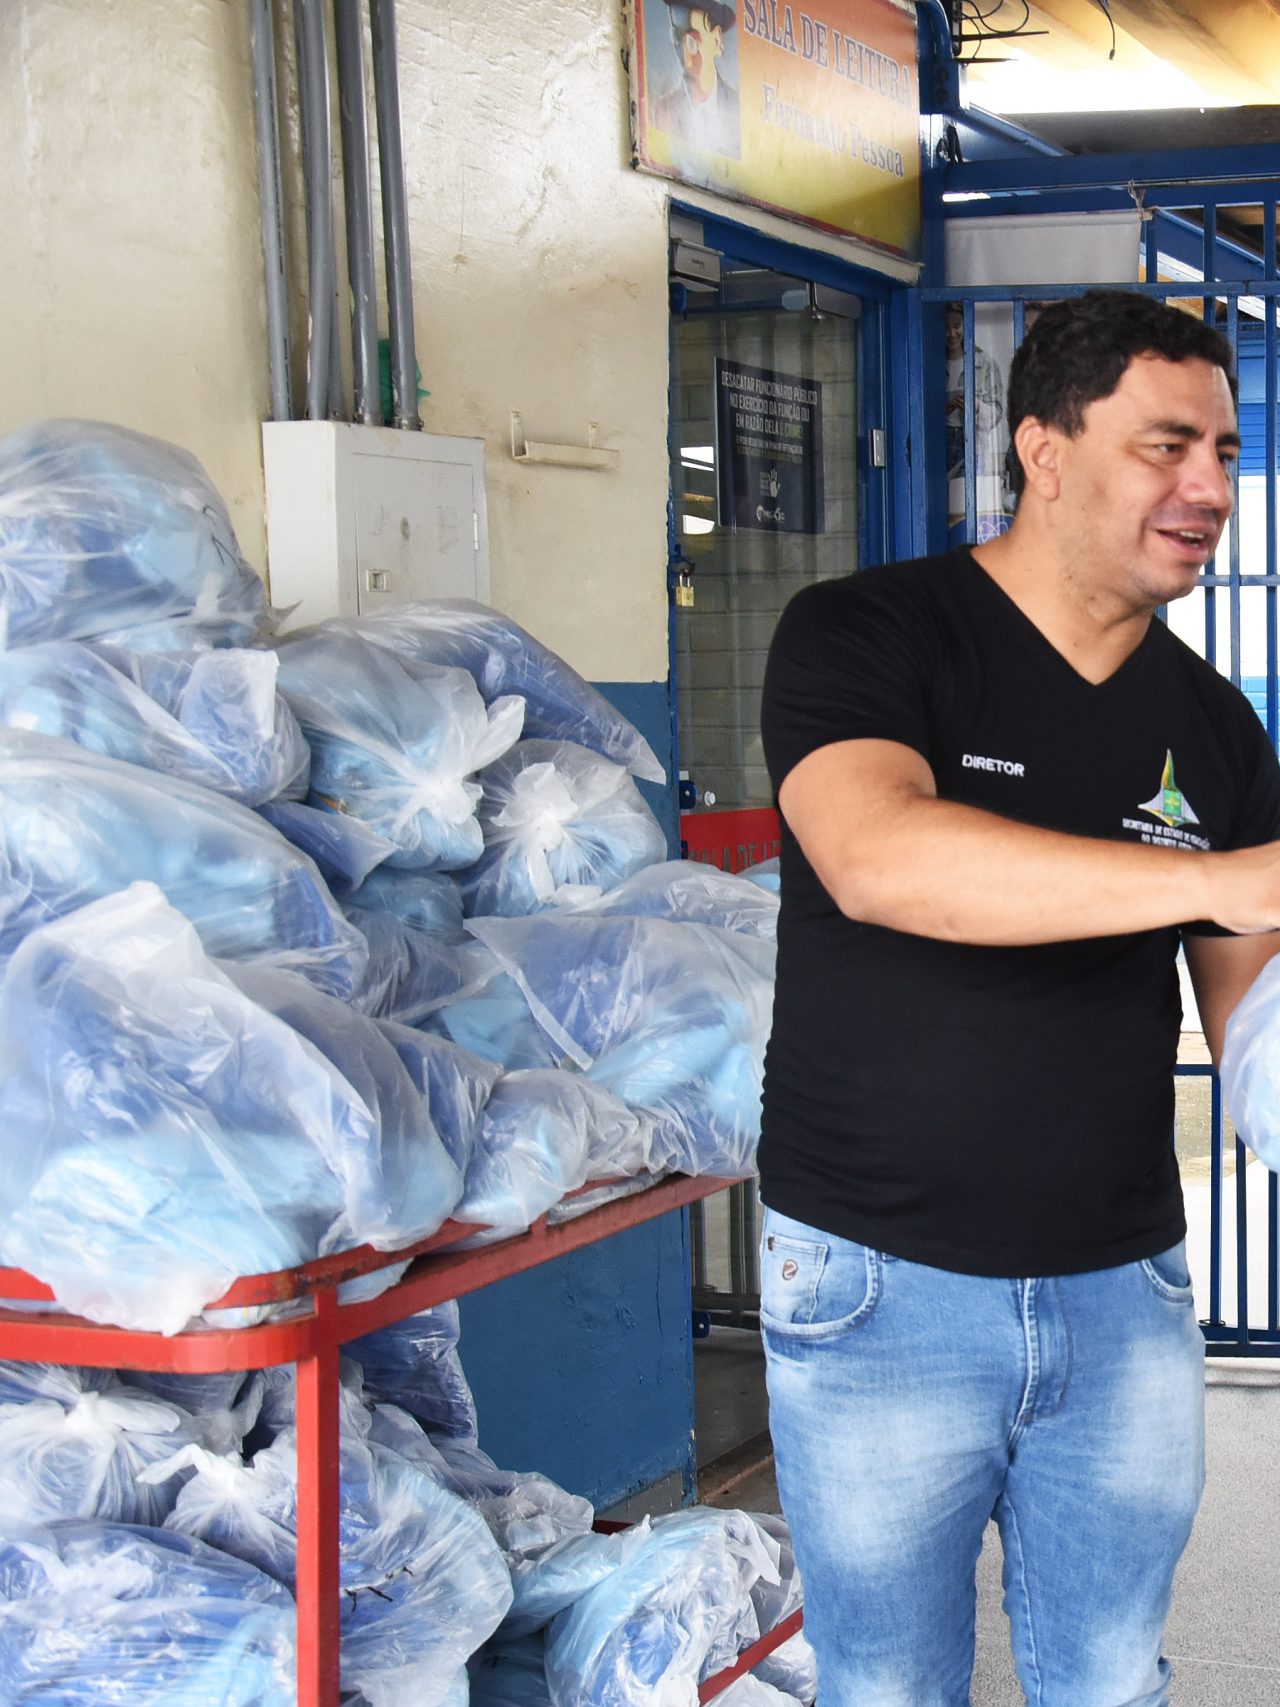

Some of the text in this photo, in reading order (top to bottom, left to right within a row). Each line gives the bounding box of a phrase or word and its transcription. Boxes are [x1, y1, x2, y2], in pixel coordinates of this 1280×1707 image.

[744, 0, 912, 106] SALA DE LEITURA
[849, 120, 905, 178] Pessoa
[962, 754, 1025, 778] DIRETOR
